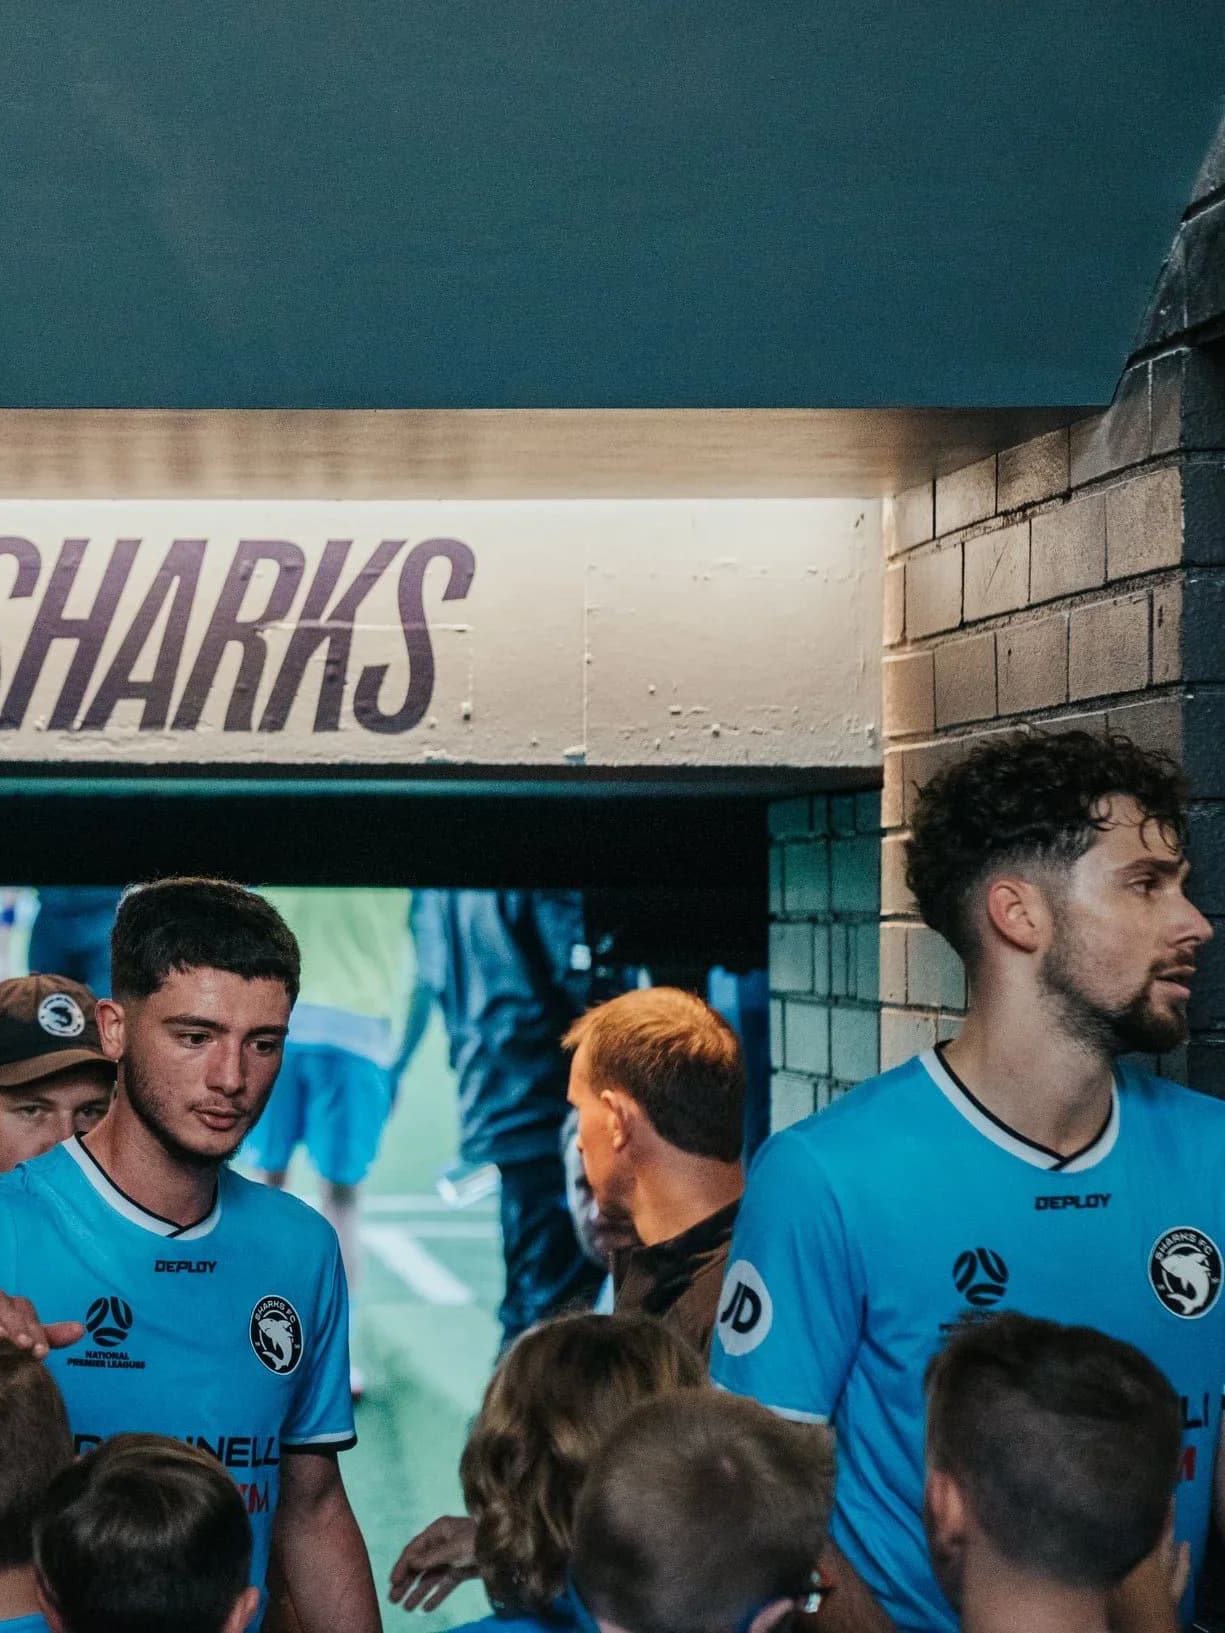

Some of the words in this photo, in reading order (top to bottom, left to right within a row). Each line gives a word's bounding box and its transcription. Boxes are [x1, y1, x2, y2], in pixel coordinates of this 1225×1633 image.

[1034, 1193, 1112, 1211] DEPLOY
[1155, 1231, 1197, 1260] SHARKS
[1197, 1239, 1214, 1256] FC
[154, 1259, 217, 1274] DEPLOY
[254, 1299, 286, 1321] SHARKS
[286, 1308, 297, 1324] FC
[719, 1281, 762, 1334] JD
[66, 1357, 106, 1369] PREMIER
[107, 1359, 146, 1370] LEAGUES
[85, 1350, 130, 1361] NATIONAL
